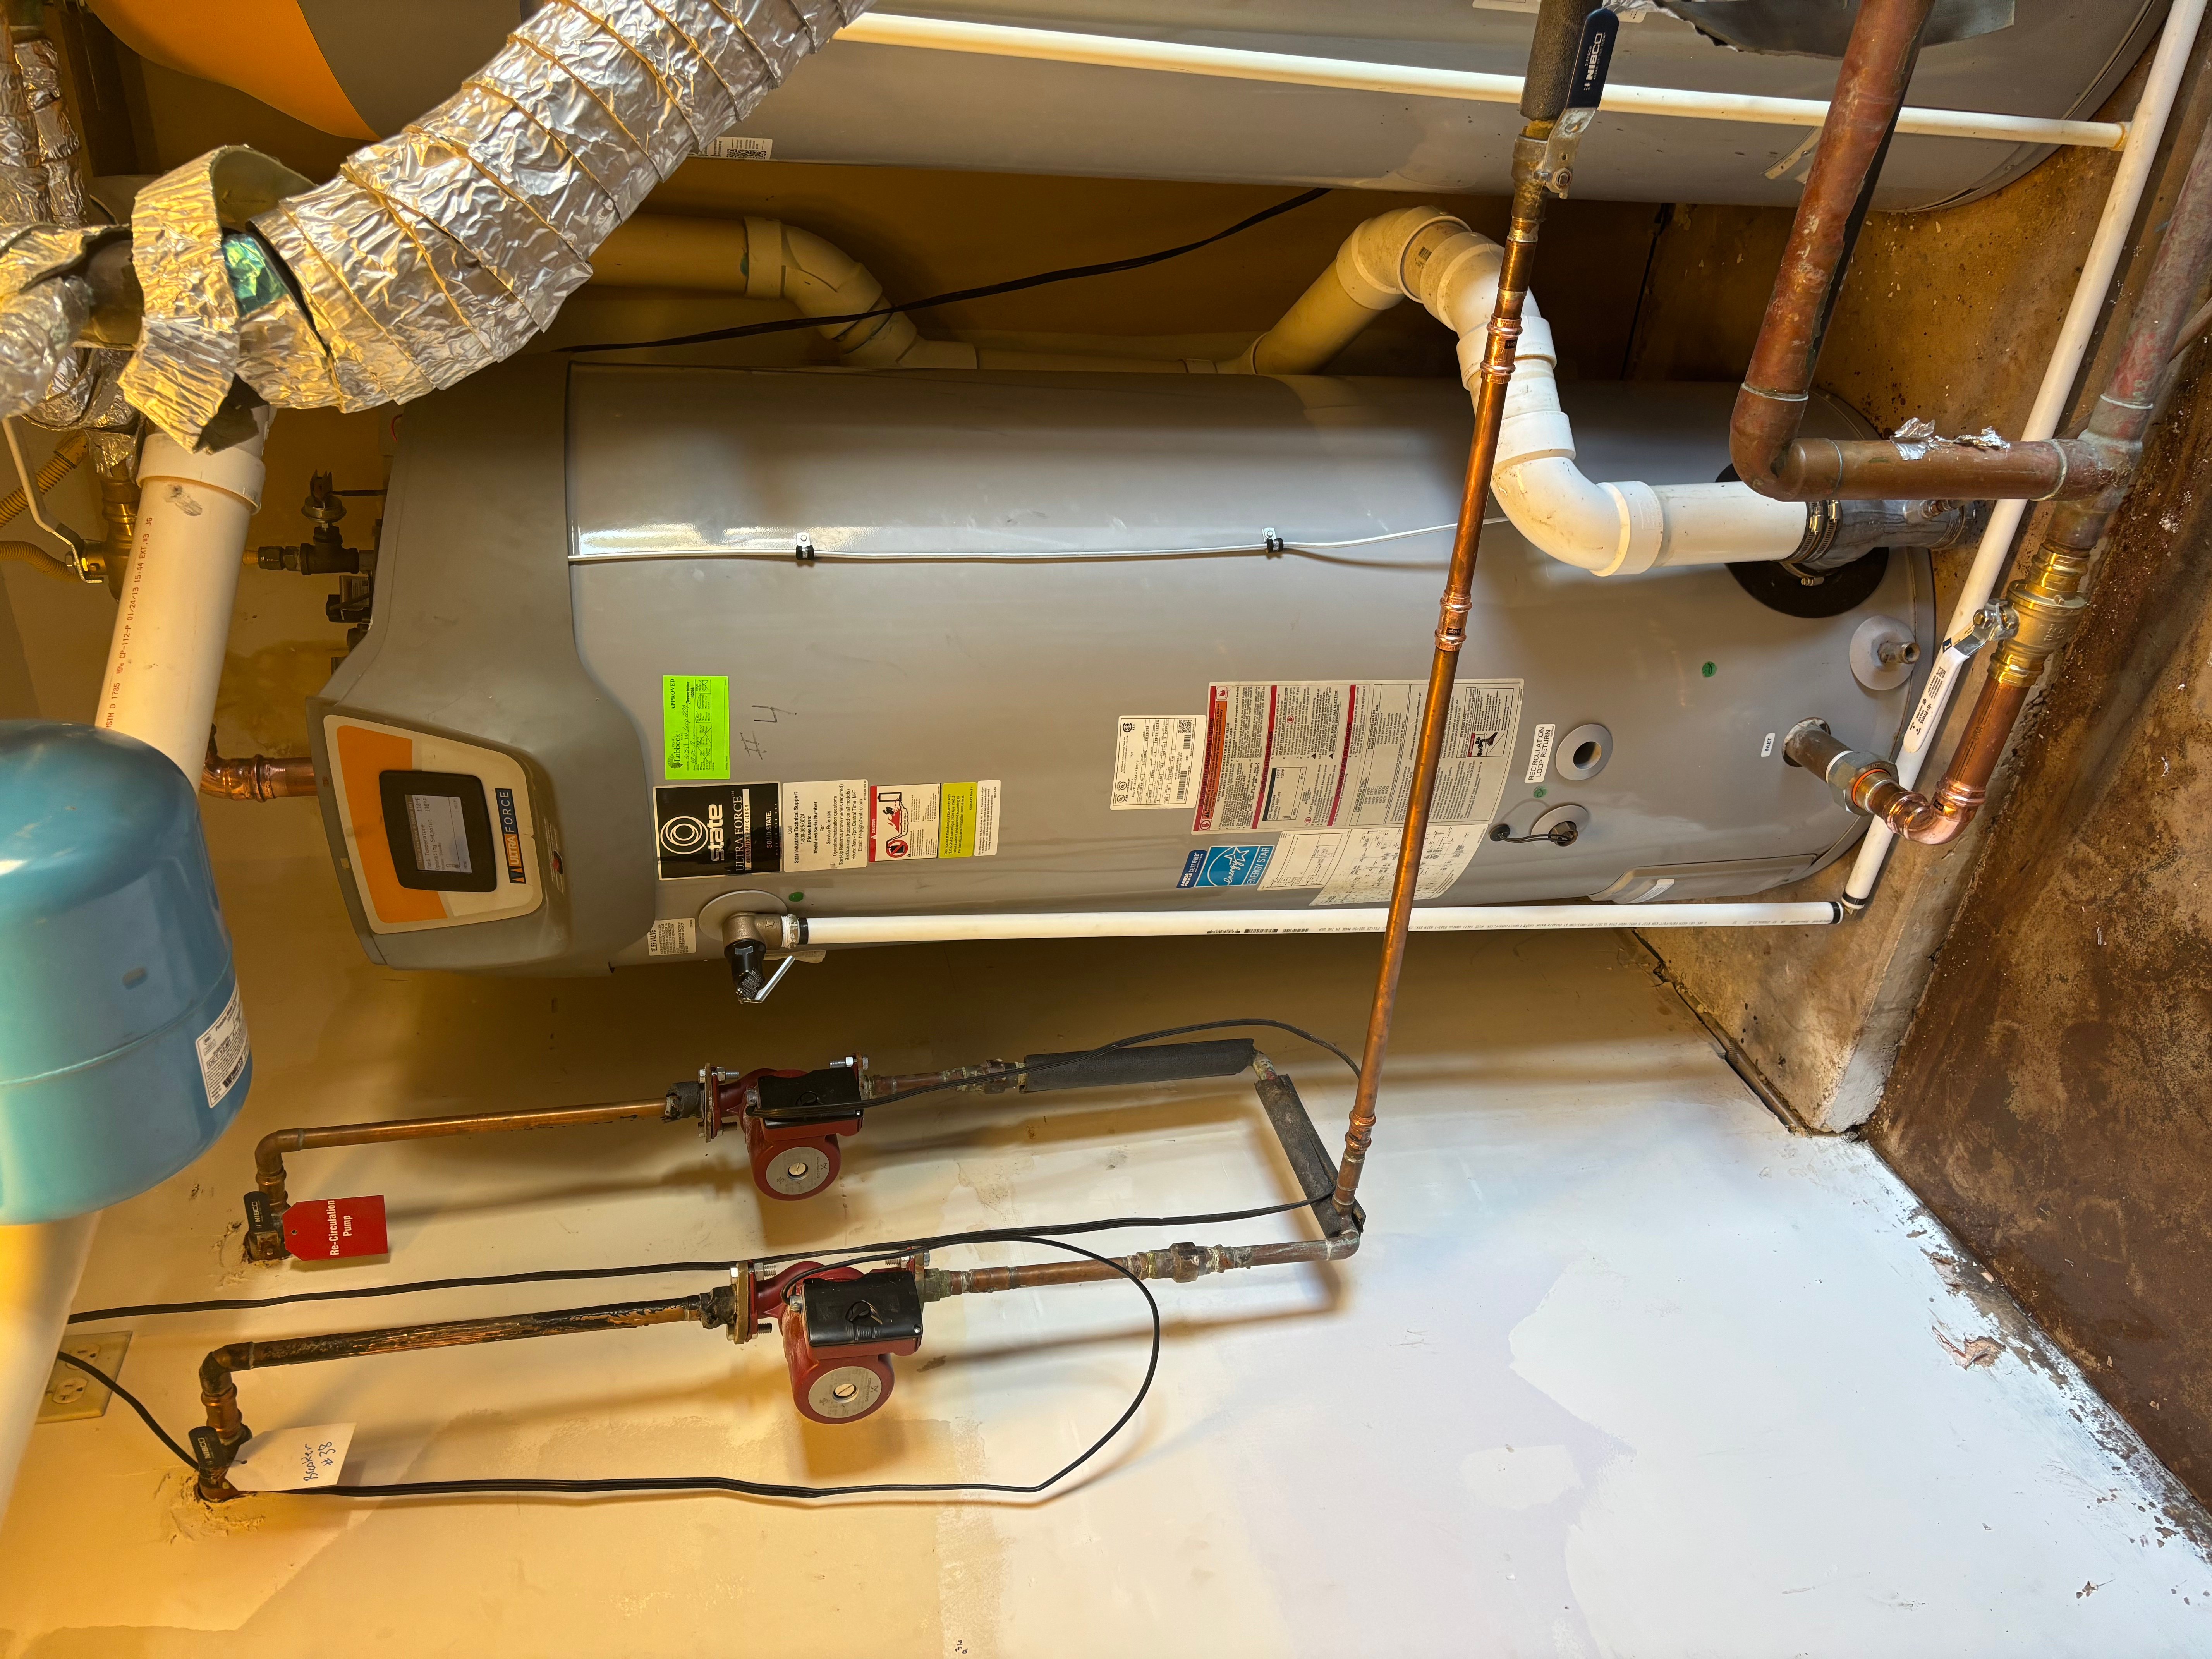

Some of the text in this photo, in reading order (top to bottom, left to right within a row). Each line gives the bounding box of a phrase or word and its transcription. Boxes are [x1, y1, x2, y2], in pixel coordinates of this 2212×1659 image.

[1585, 33, 1603, 80] NIBCO
[111, 683, 120, 699] 1785
[119, 625, 131, 658] CP-112-P
[127, 587, 139, 621] 01/24/13
[134, 563, 144, 583] 15:44
[1528, 727, 1545, 780] RECIRCULATION
[1535, 730, 1551, 777] LOOP RETURN
[421, 824, 430, 855] Temperature
[427, 819, 436, 842] Setpoint
[499, 792, 519, 865] ULTRA FORCE
[707, 804, 725, 862] state
[432, 845, 440, 871] Operating
[735, 836, 744, 871] ULTRA
[1223, 859, 1245, 883] energy
[1246, 847, 1271, 884] ENERGY STAR
[1180, 873, 1193, 886] AHRI
[251, 1201, 261, 1223] NIBCO
[326, 1200, 340, 1255] Re-Circulation
[342, 1215, 353, 1237] Pump
[198, 1437, 211, 1459] NIBCO
[301, 1443, 318, 1482] Breaker
[318, 1441, 336, 1466] #38
